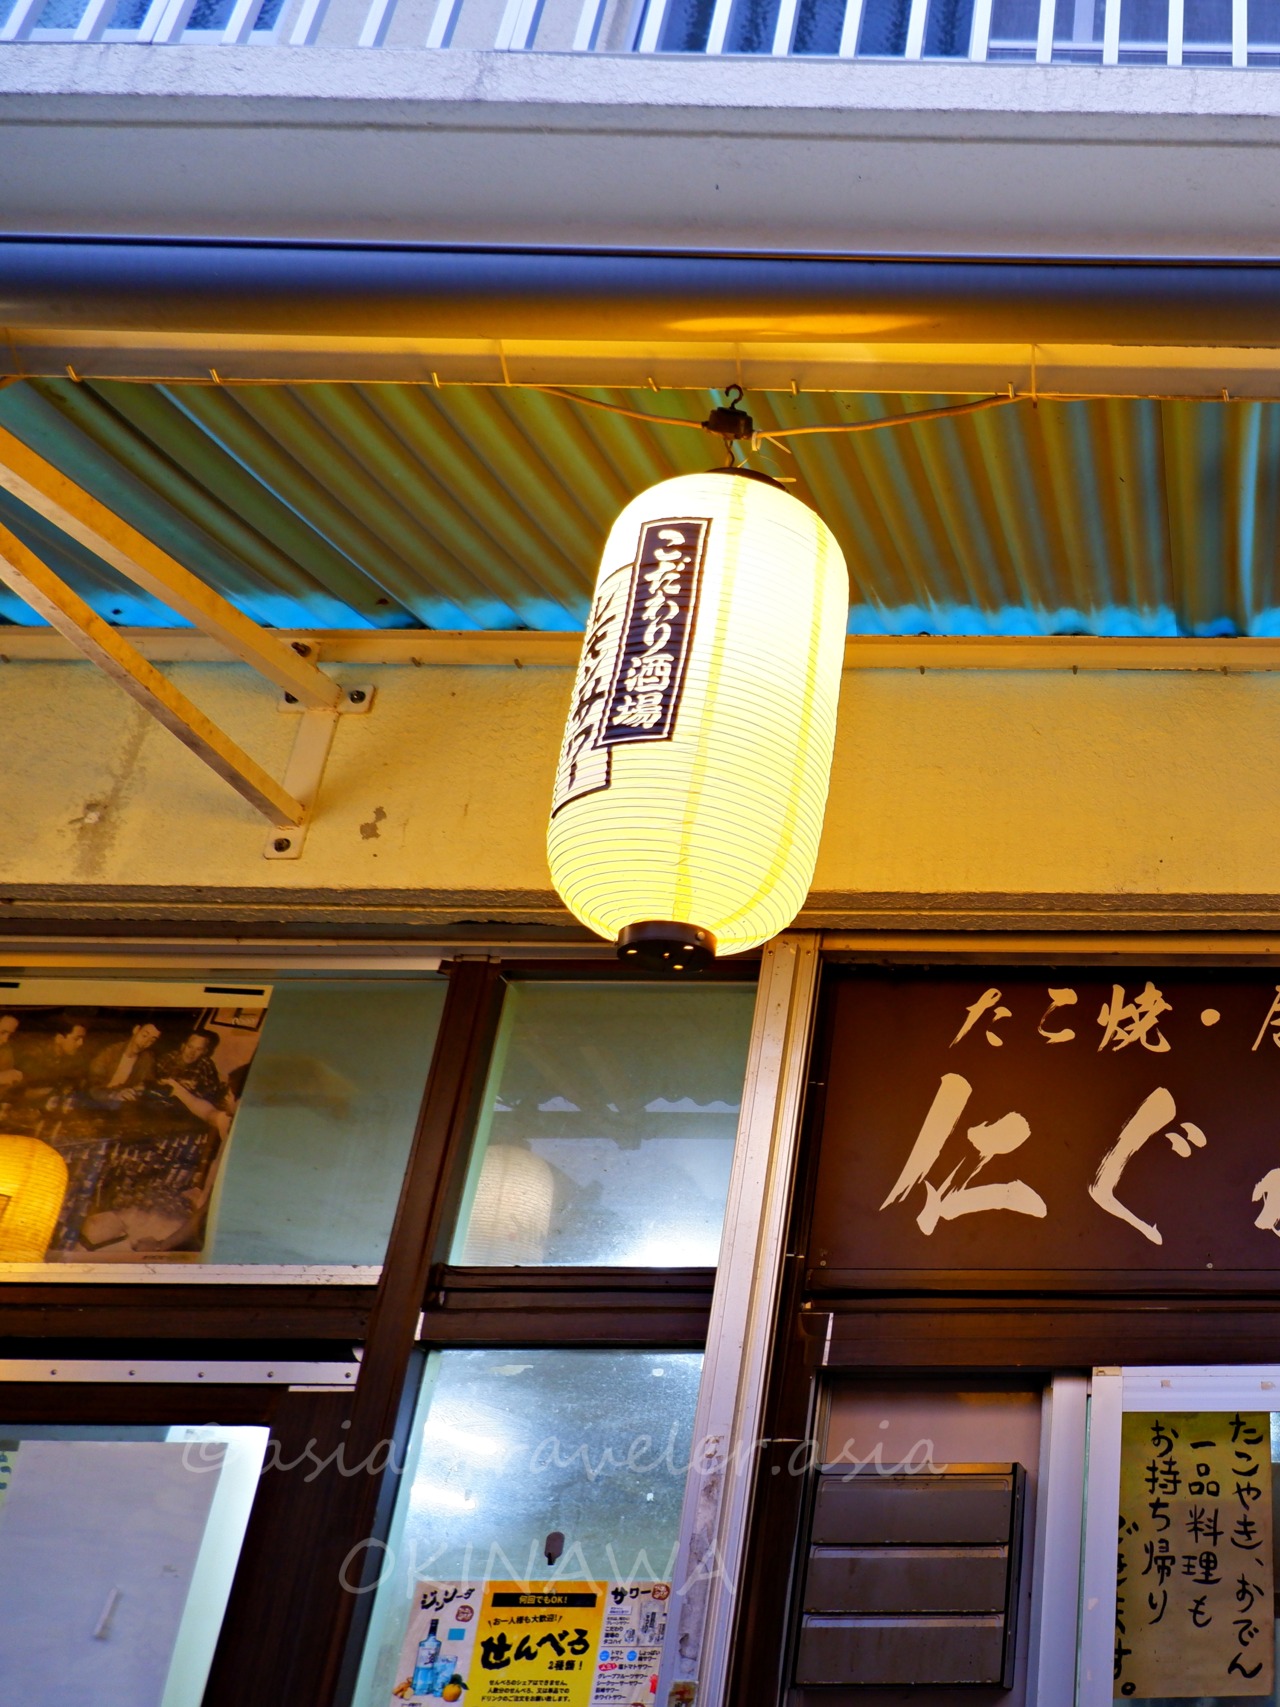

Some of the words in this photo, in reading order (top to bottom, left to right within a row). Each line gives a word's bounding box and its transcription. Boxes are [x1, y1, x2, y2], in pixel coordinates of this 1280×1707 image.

[612, 529, 689, 730] こだわり酒場
[611, 1587, 652, 1605] サワー
[1142, 1419, 1182, 1626] お持ち帰り
[1181, 1439, 1224, 1628] 一品料理も
[1227, 1412, 1264, 1679] たこやき、おでん
[480, 1628, 590, 1671] せんべろ
